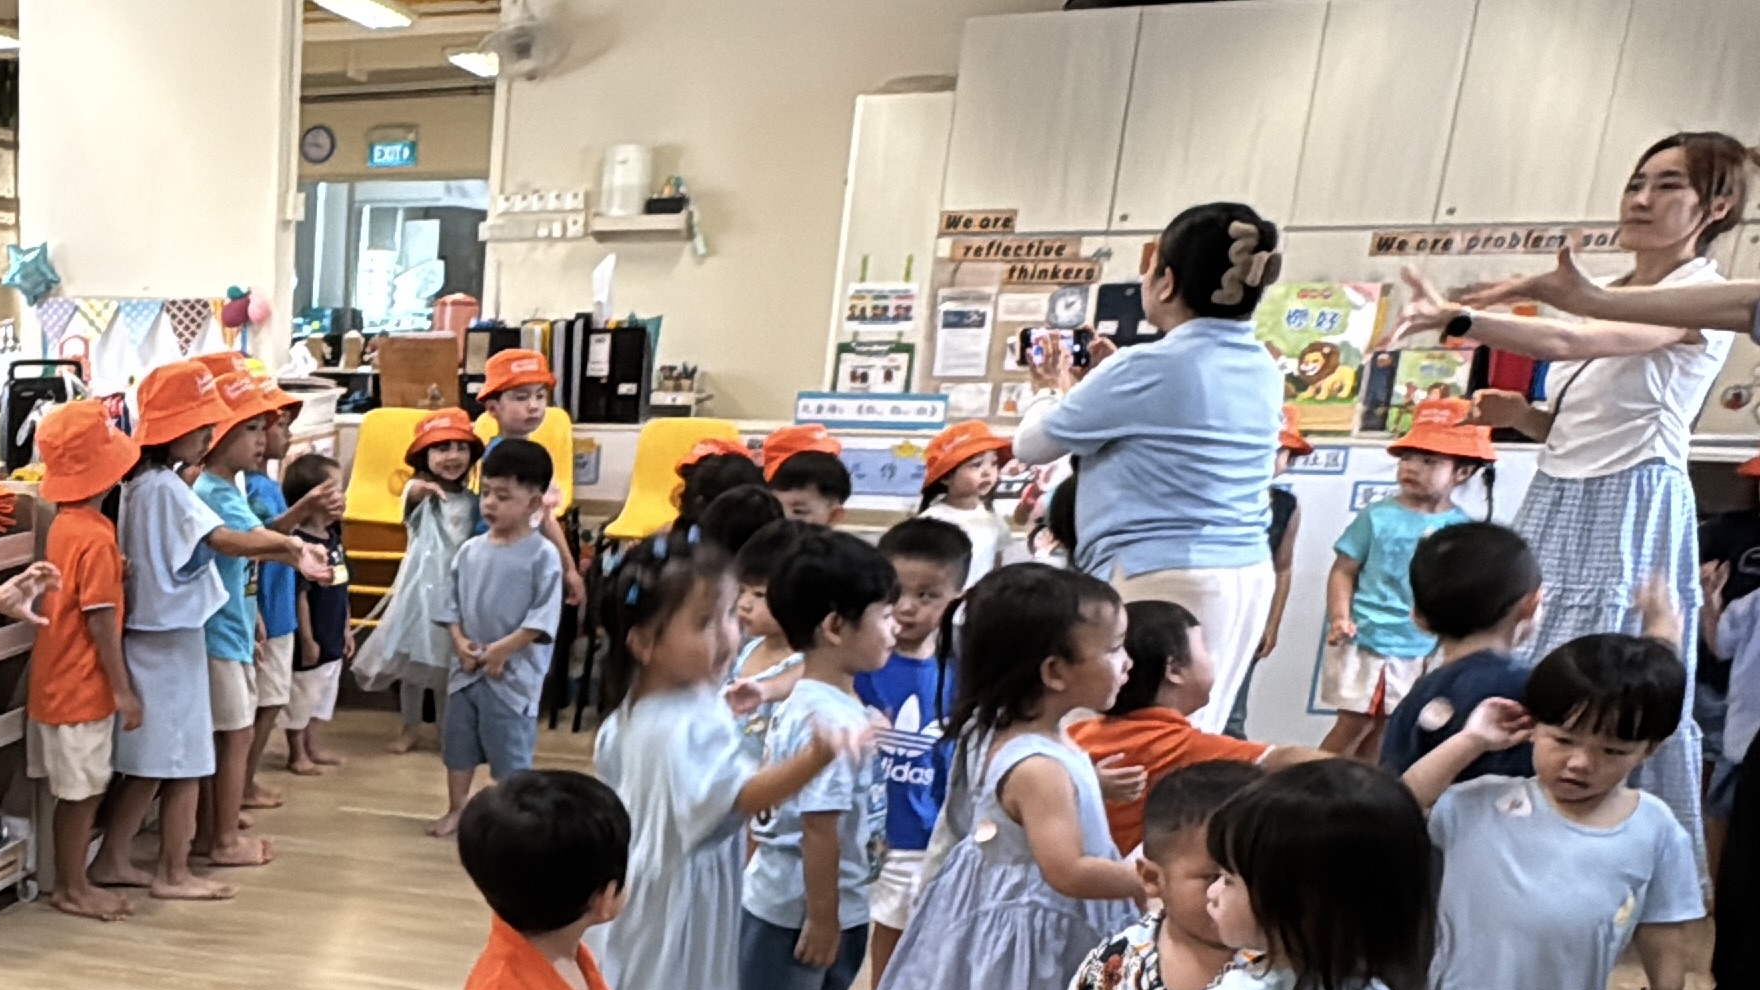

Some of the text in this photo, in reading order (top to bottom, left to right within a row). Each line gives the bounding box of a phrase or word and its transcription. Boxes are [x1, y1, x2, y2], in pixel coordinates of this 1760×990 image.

[945, 214, 973, 229] We
[962, 239, 1066, 258] reflective
[1376, 236, 1408, 252] We
[1465, 229, 1567, 255] problem
[1008, 262, 1096, 281] thinkers
